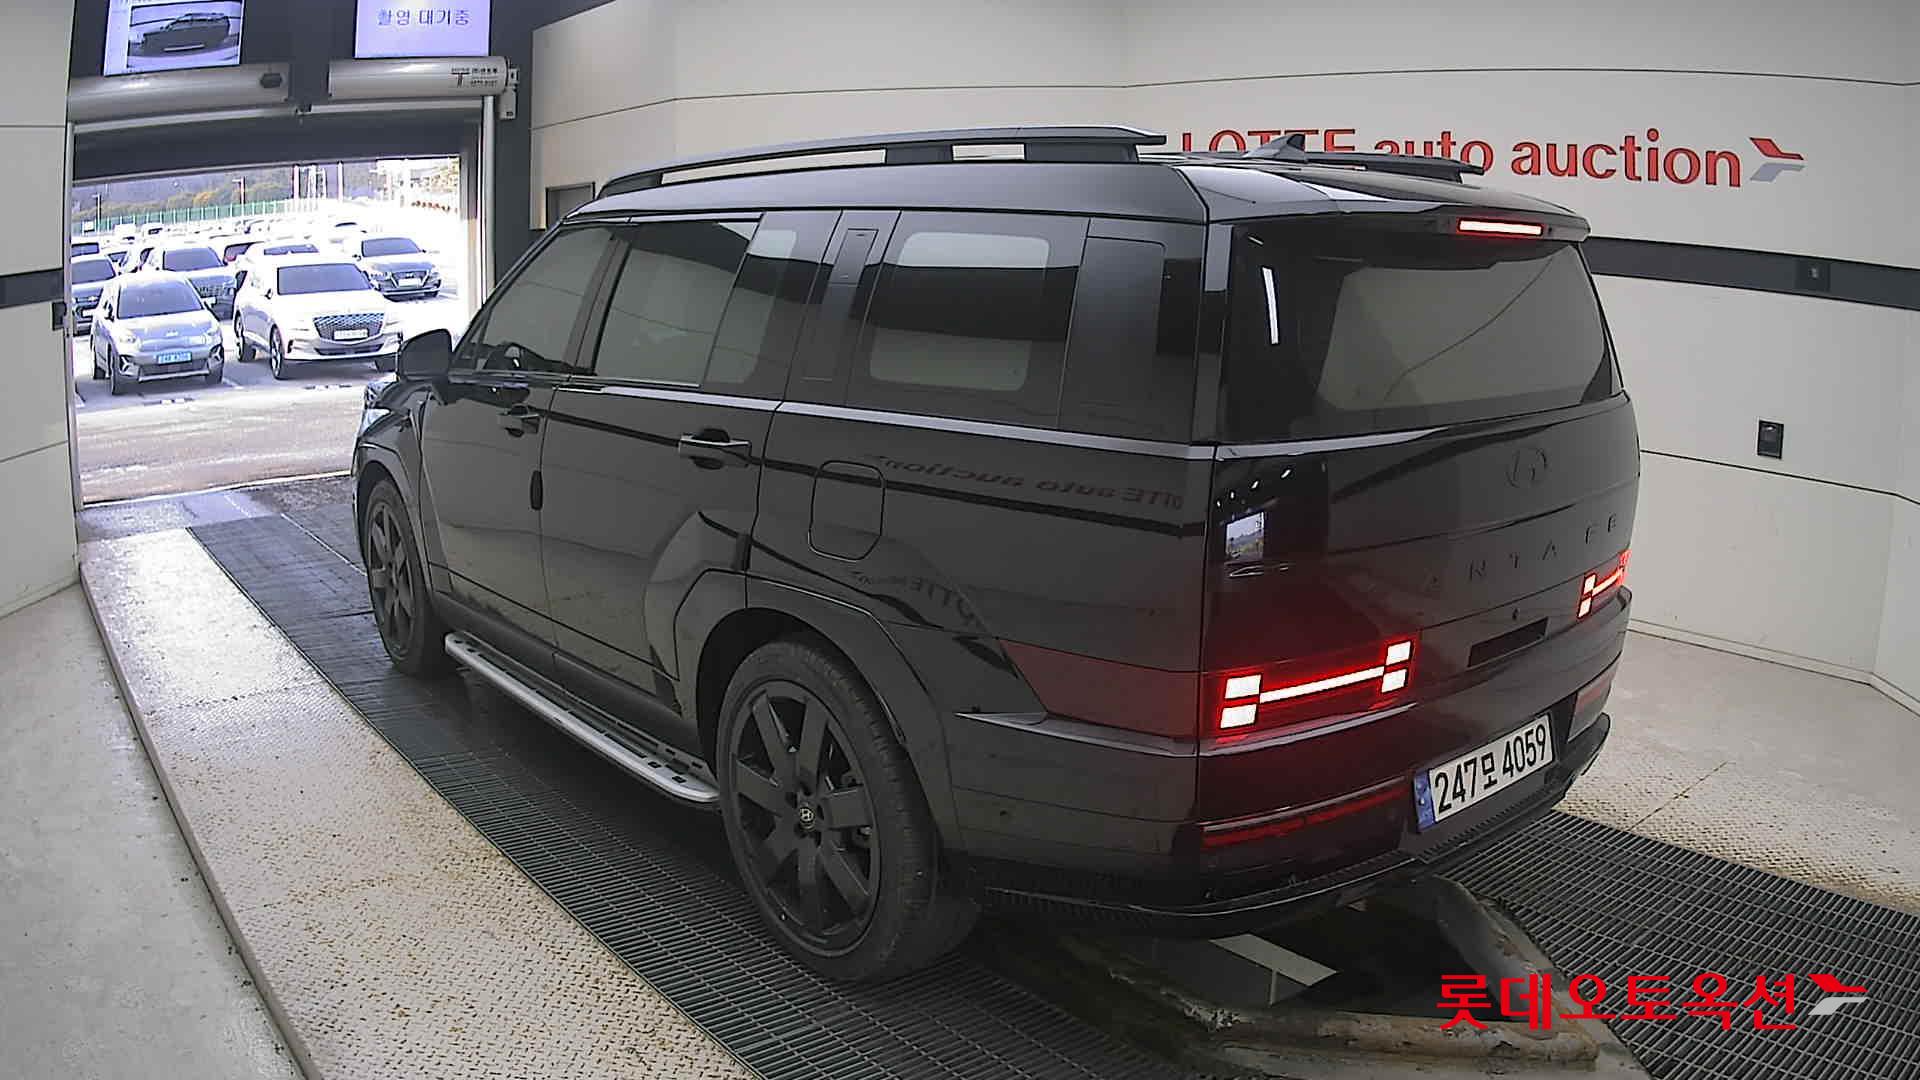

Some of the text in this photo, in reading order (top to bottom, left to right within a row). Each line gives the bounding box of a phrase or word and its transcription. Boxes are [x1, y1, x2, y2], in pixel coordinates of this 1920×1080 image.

[418, 8, 470, 26] 대기중
[1510, 127, 1742, 188] auction
[1434, 724, 1547, 815] 247모 4059
